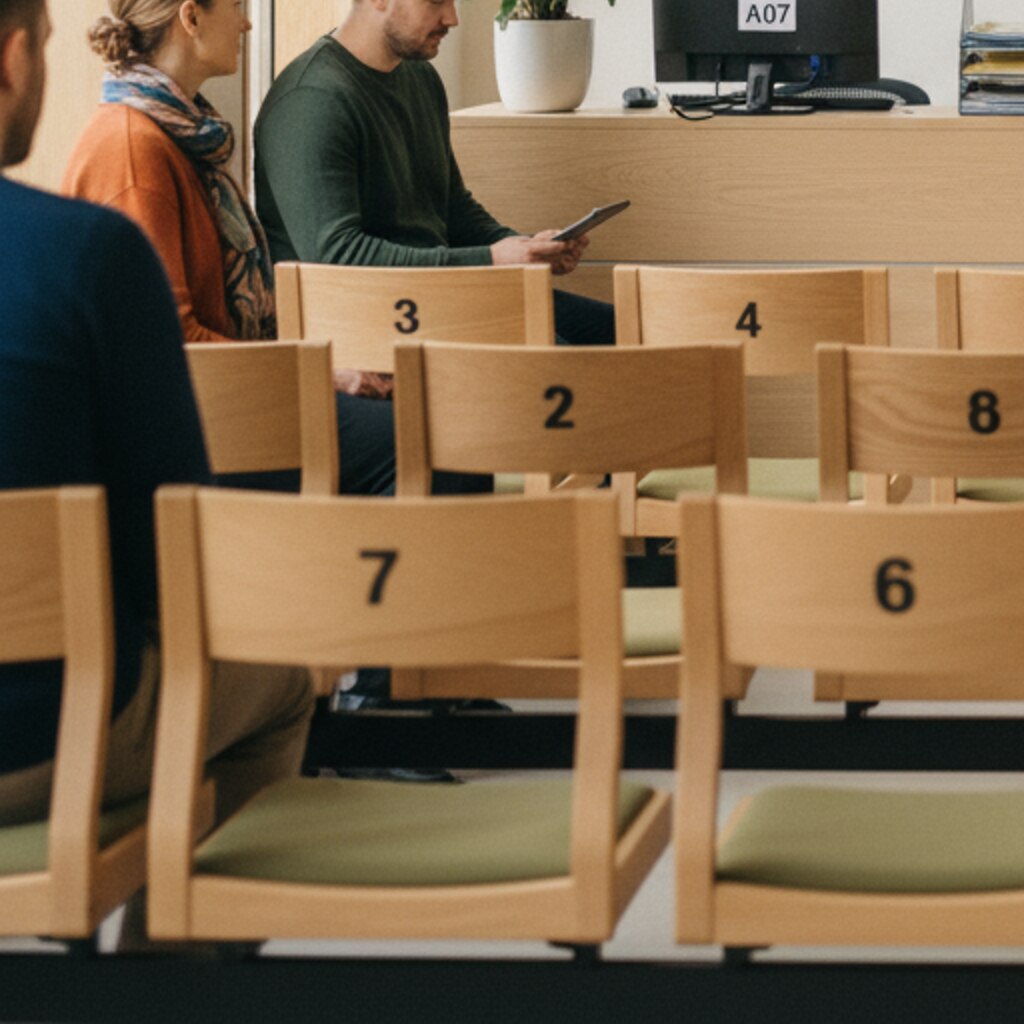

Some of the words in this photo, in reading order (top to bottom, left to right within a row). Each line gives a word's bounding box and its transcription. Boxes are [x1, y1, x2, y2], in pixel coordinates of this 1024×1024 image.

[745, 3, 791, 25] A07
[394, 298, 420, 335] 3
[735, 301, 763, 339] 4
[543, 384, 575, 430] 2
[968, 389, 1002, 435] 8
[358, 549, 399, 606] 7
[874, 557, 917, 614] 6
